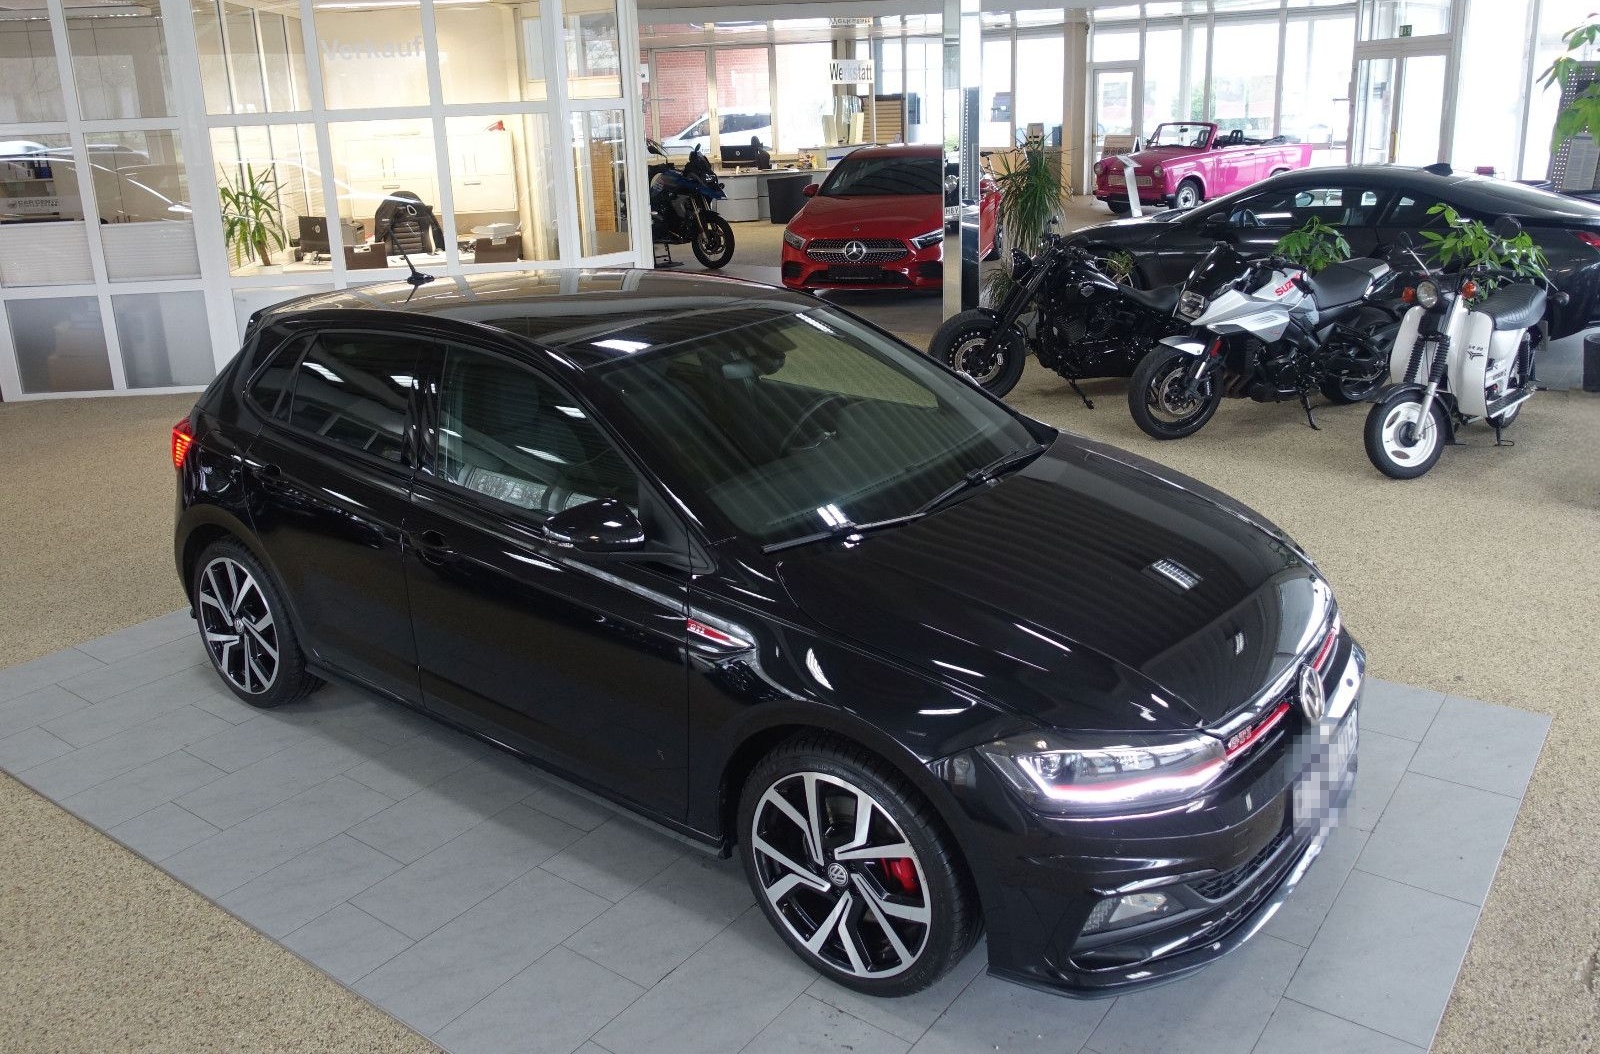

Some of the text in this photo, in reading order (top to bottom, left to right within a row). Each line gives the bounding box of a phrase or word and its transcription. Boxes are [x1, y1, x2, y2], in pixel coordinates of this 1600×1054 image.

[319, 35, 423, 61] Verkauf
[829, 62, 873, 81] Werkstatt
[1275, 271, 1301, 297] SUZ
[1227, 724, 1253, 750] GTI
